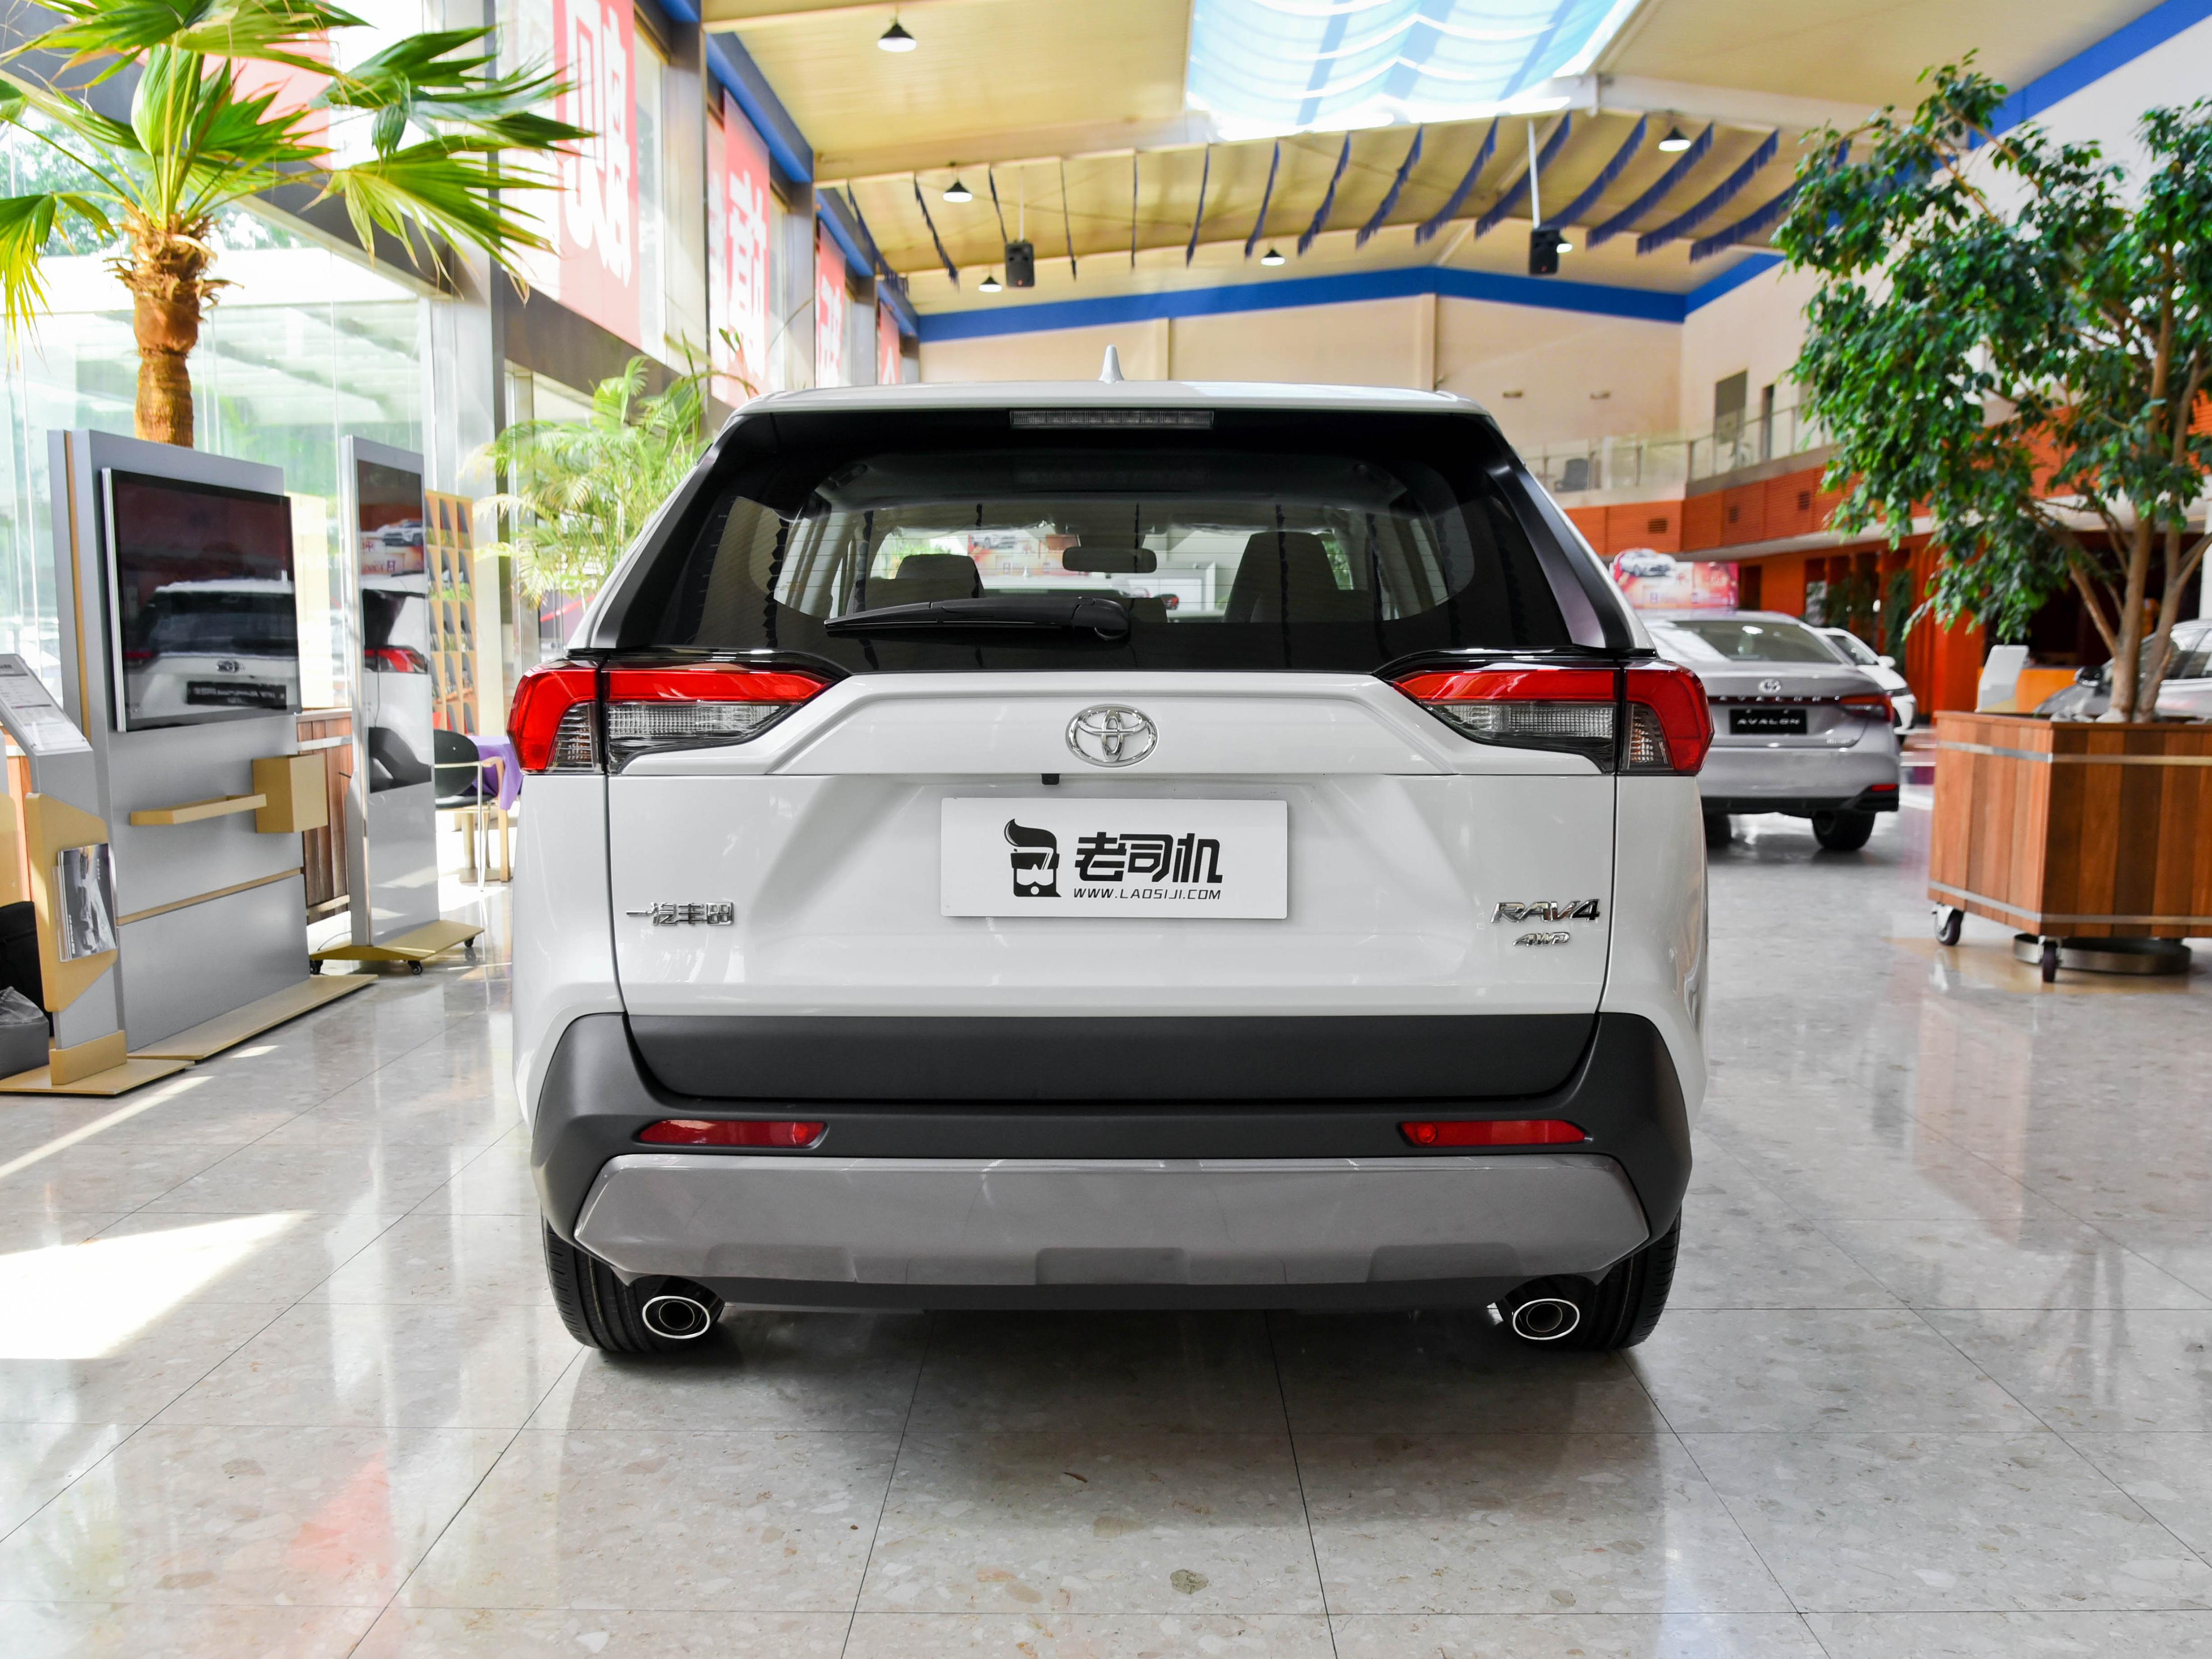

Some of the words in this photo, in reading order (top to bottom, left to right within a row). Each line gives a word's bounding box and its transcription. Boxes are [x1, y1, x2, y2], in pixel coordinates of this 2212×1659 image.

[1074, 832, 1223, 883] 老司机
[1073, 888, 1221, 900] WWW.LAOSIJI.COM
[626, 902, 734, 926] 一汽丰田
[1490, 899, 1600, 923] RAV4
